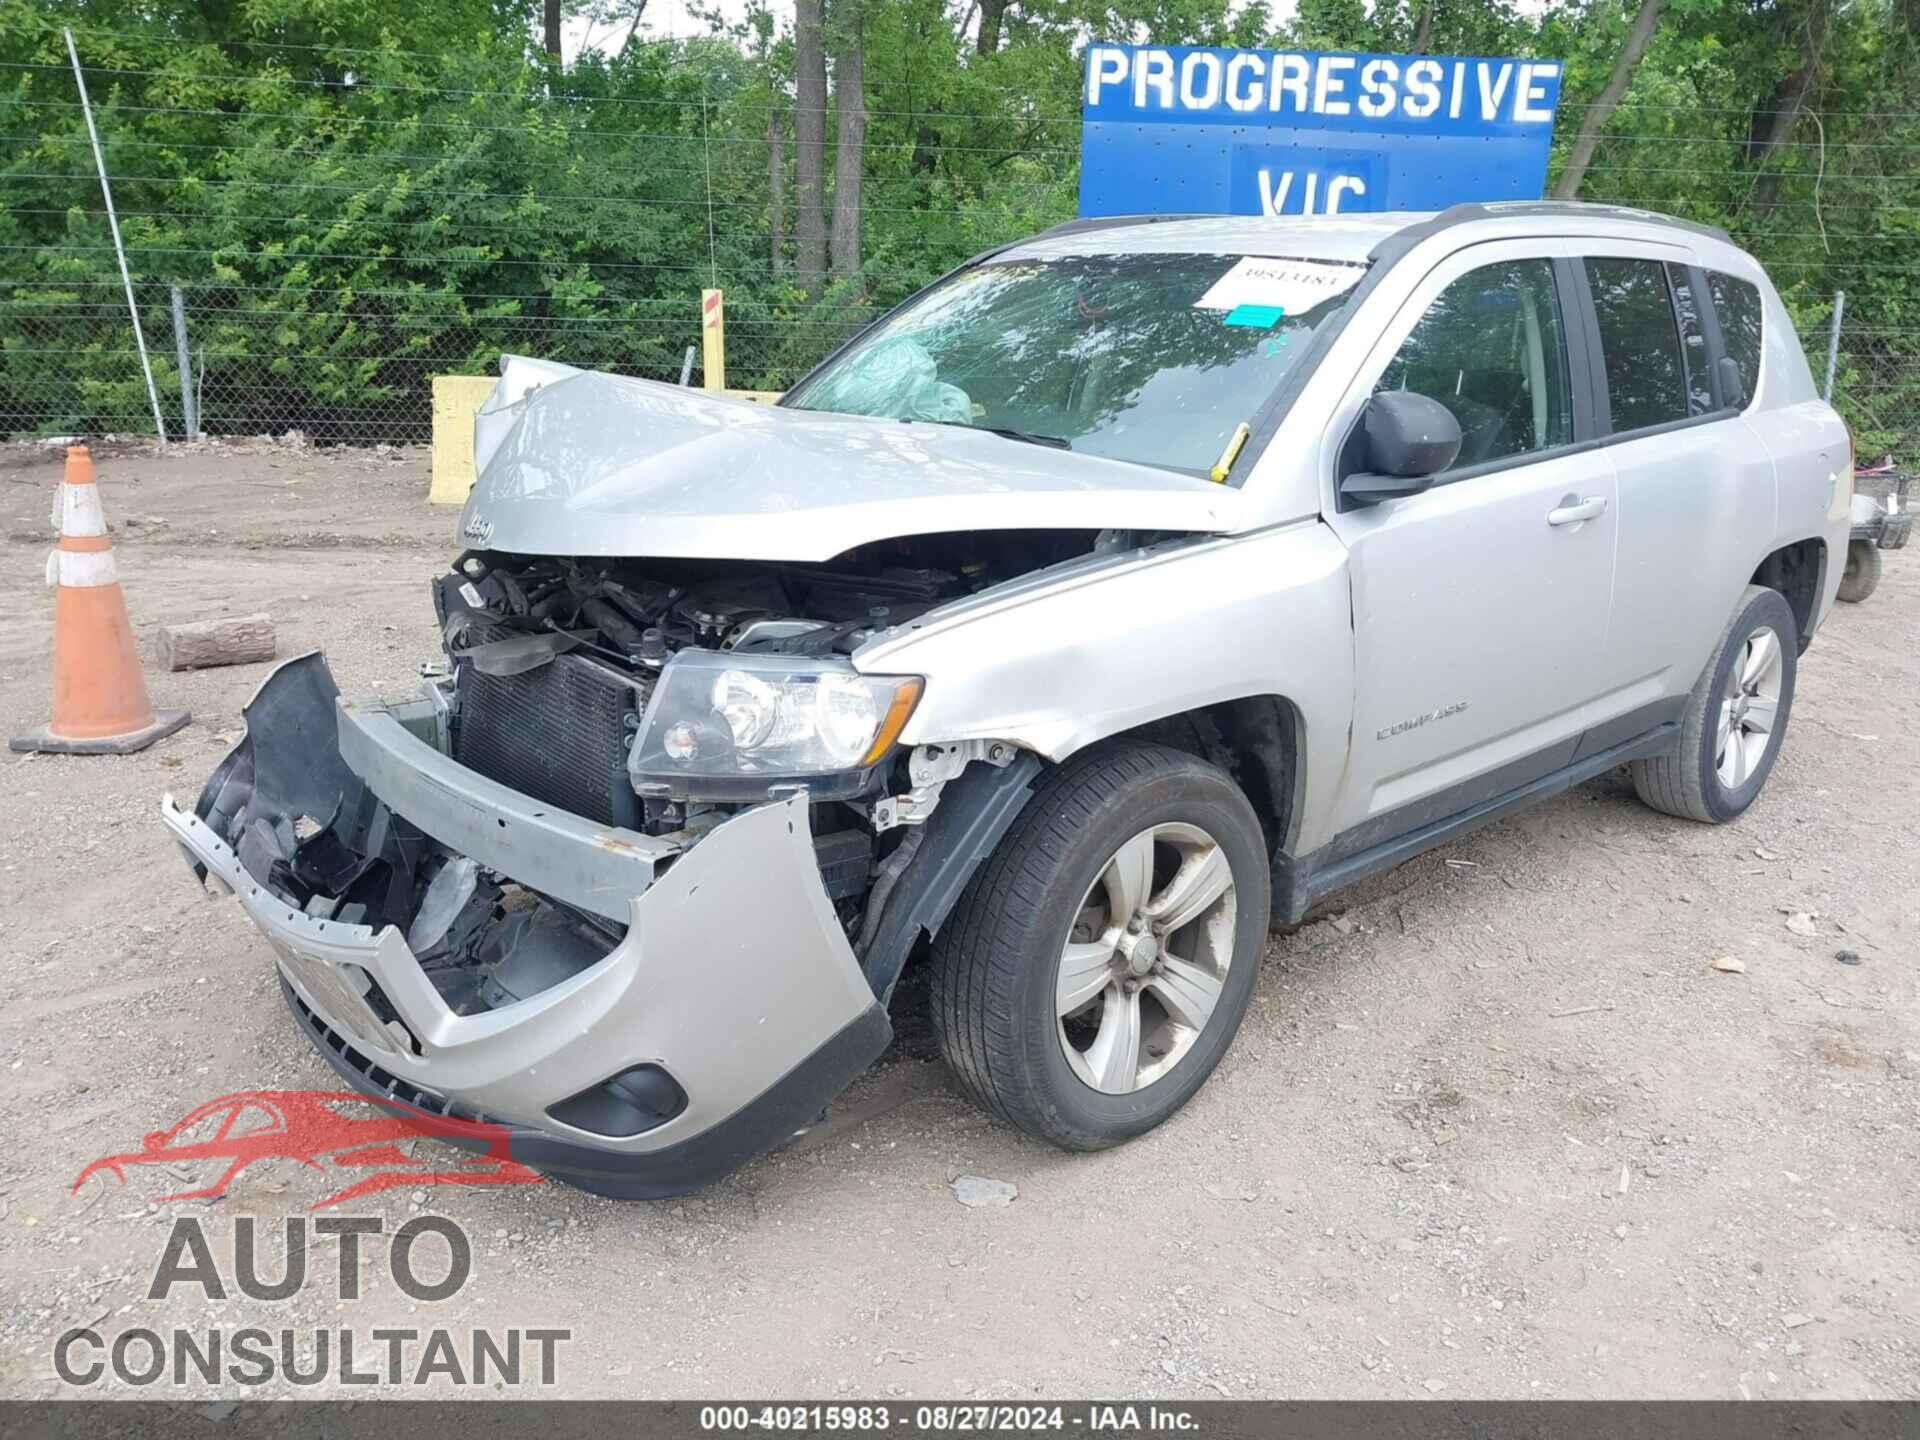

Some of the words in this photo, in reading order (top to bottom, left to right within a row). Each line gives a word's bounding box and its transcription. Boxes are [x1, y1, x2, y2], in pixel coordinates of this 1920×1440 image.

[1088, 47, 1560, 122] PROGRESSIVE
[1257, 170, 1366, 216] VIC
[1376, 701, 1470, 741] COMPASS
